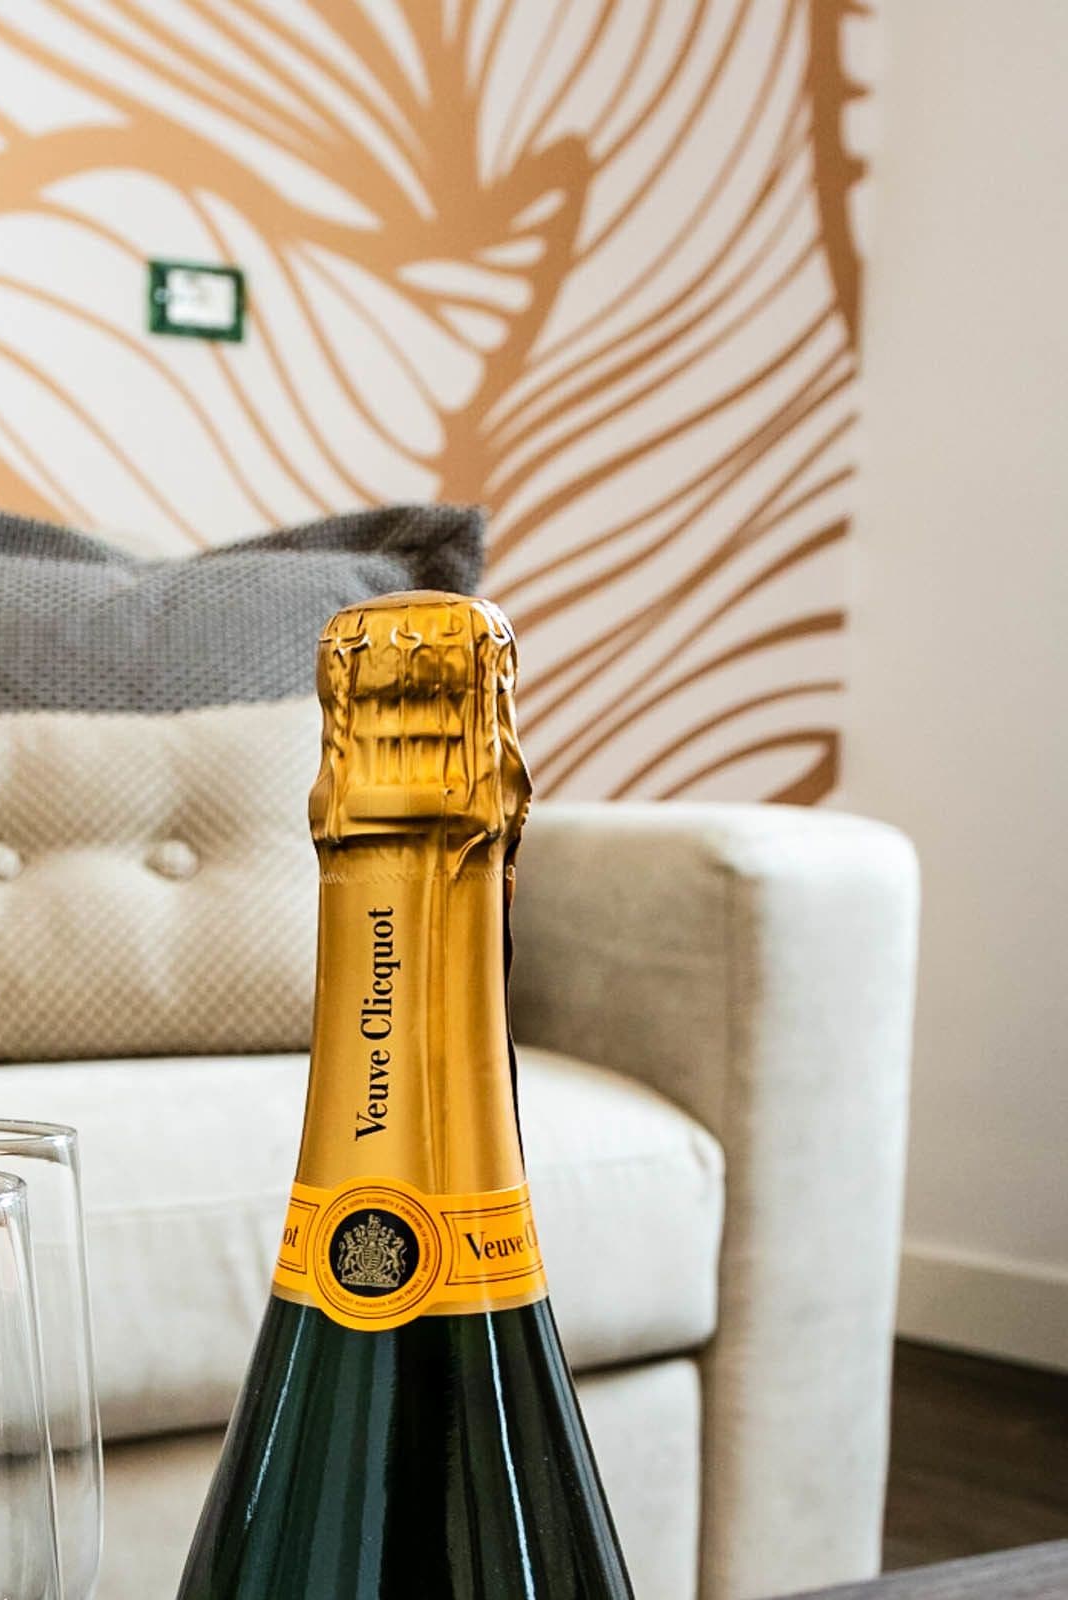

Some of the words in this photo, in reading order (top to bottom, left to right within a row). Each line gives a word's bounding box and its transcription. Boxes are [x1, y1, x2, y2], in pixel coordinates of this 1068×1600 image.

[360, 906, 402, 1041] Clicquot
[354, 1049, 391, 1142] Veuve
[462, 1230, 524, 1261] Veuve
